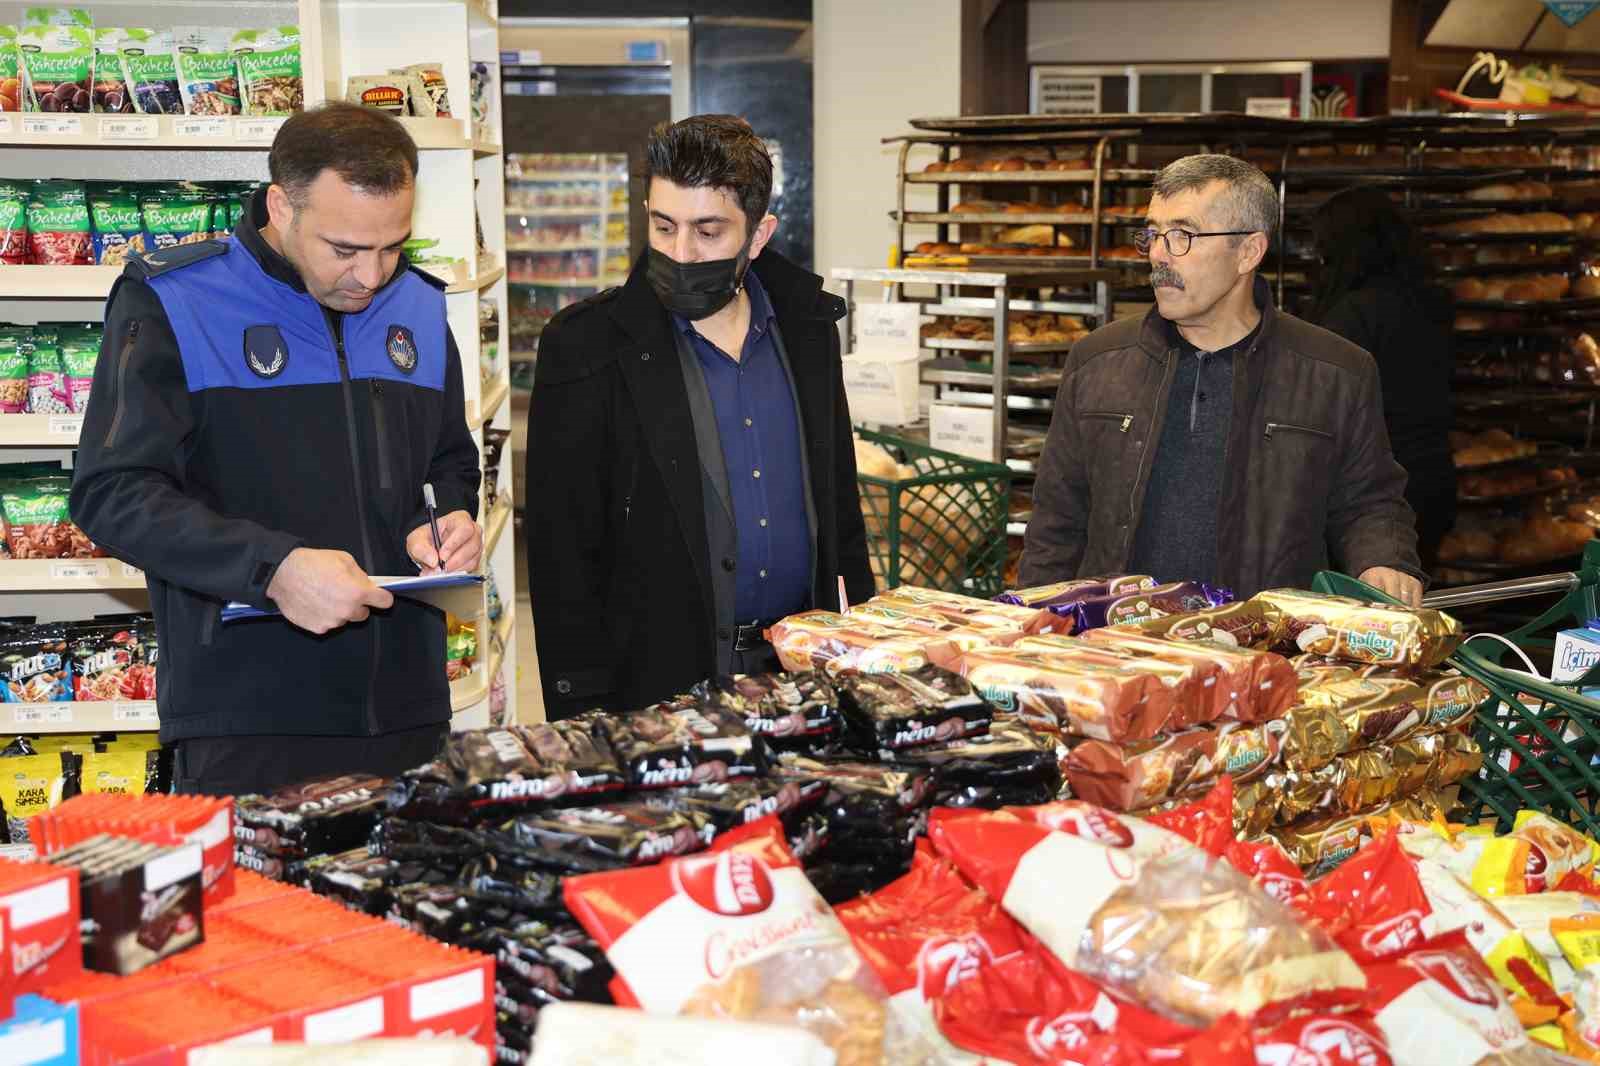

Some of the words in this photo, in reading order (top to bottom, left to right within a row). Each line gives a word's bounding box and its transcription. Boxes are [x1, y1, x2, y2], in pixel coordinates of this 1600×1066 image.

[1347, 630, 1395, 658] halley
[895, 725, 936, 745] nero
[1226, 748, 1264, 771] halley
[642, 767, 693, 784] nero
[18, 787, 45, 798] KARA
[491, 778, 544, 799] nero
[234, 826, 256, 841] ero
